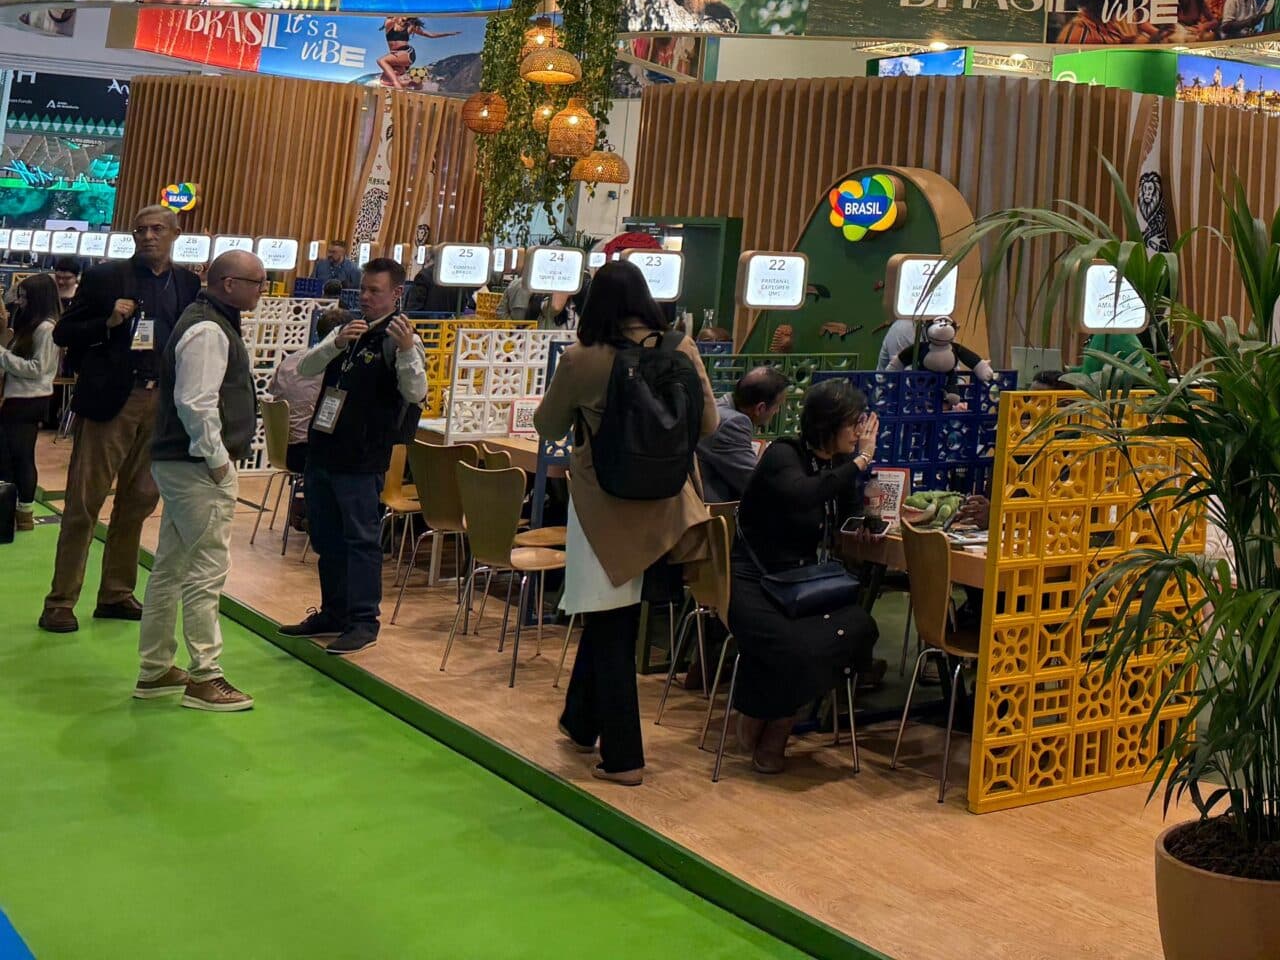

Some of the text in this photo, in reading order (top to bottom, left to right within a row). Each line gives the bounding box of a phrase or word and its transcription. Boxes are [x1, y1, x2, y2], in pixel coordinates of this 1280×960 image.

[184, 9, 288, 50] BRASIL
[324, 21, 338, 39] a
[844, 201, 883, 216] BRASIL
[458, 248, 474, 258] 25
[549, 252, 565, 262] 24
[645, 256, 662, 267] 23
[769, 259, 786, 271] 22
